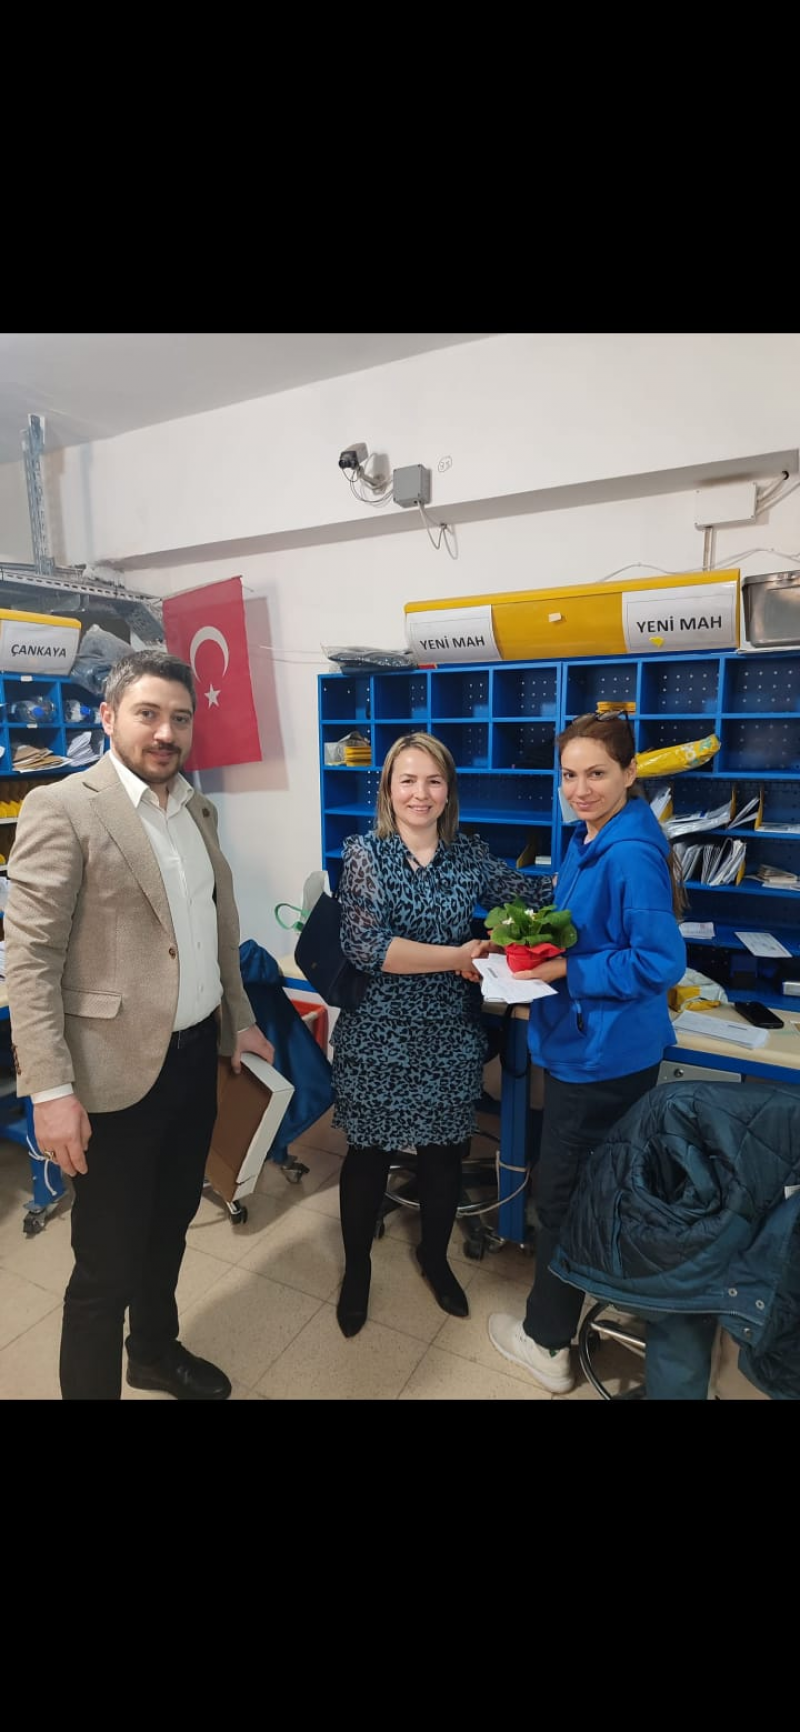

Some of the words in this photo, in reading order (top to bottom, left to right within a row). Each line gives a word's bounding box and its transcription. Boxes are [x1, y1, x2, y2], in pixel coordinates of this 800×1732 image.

[636, 616, 674, 633] YENİ
[680, 616, 722, 631] MAH
[419, 635, 450, 650] YENİ
[452, 635, 485, 648] MAH
[11, 644, 67, 657] ÇANKAYA
